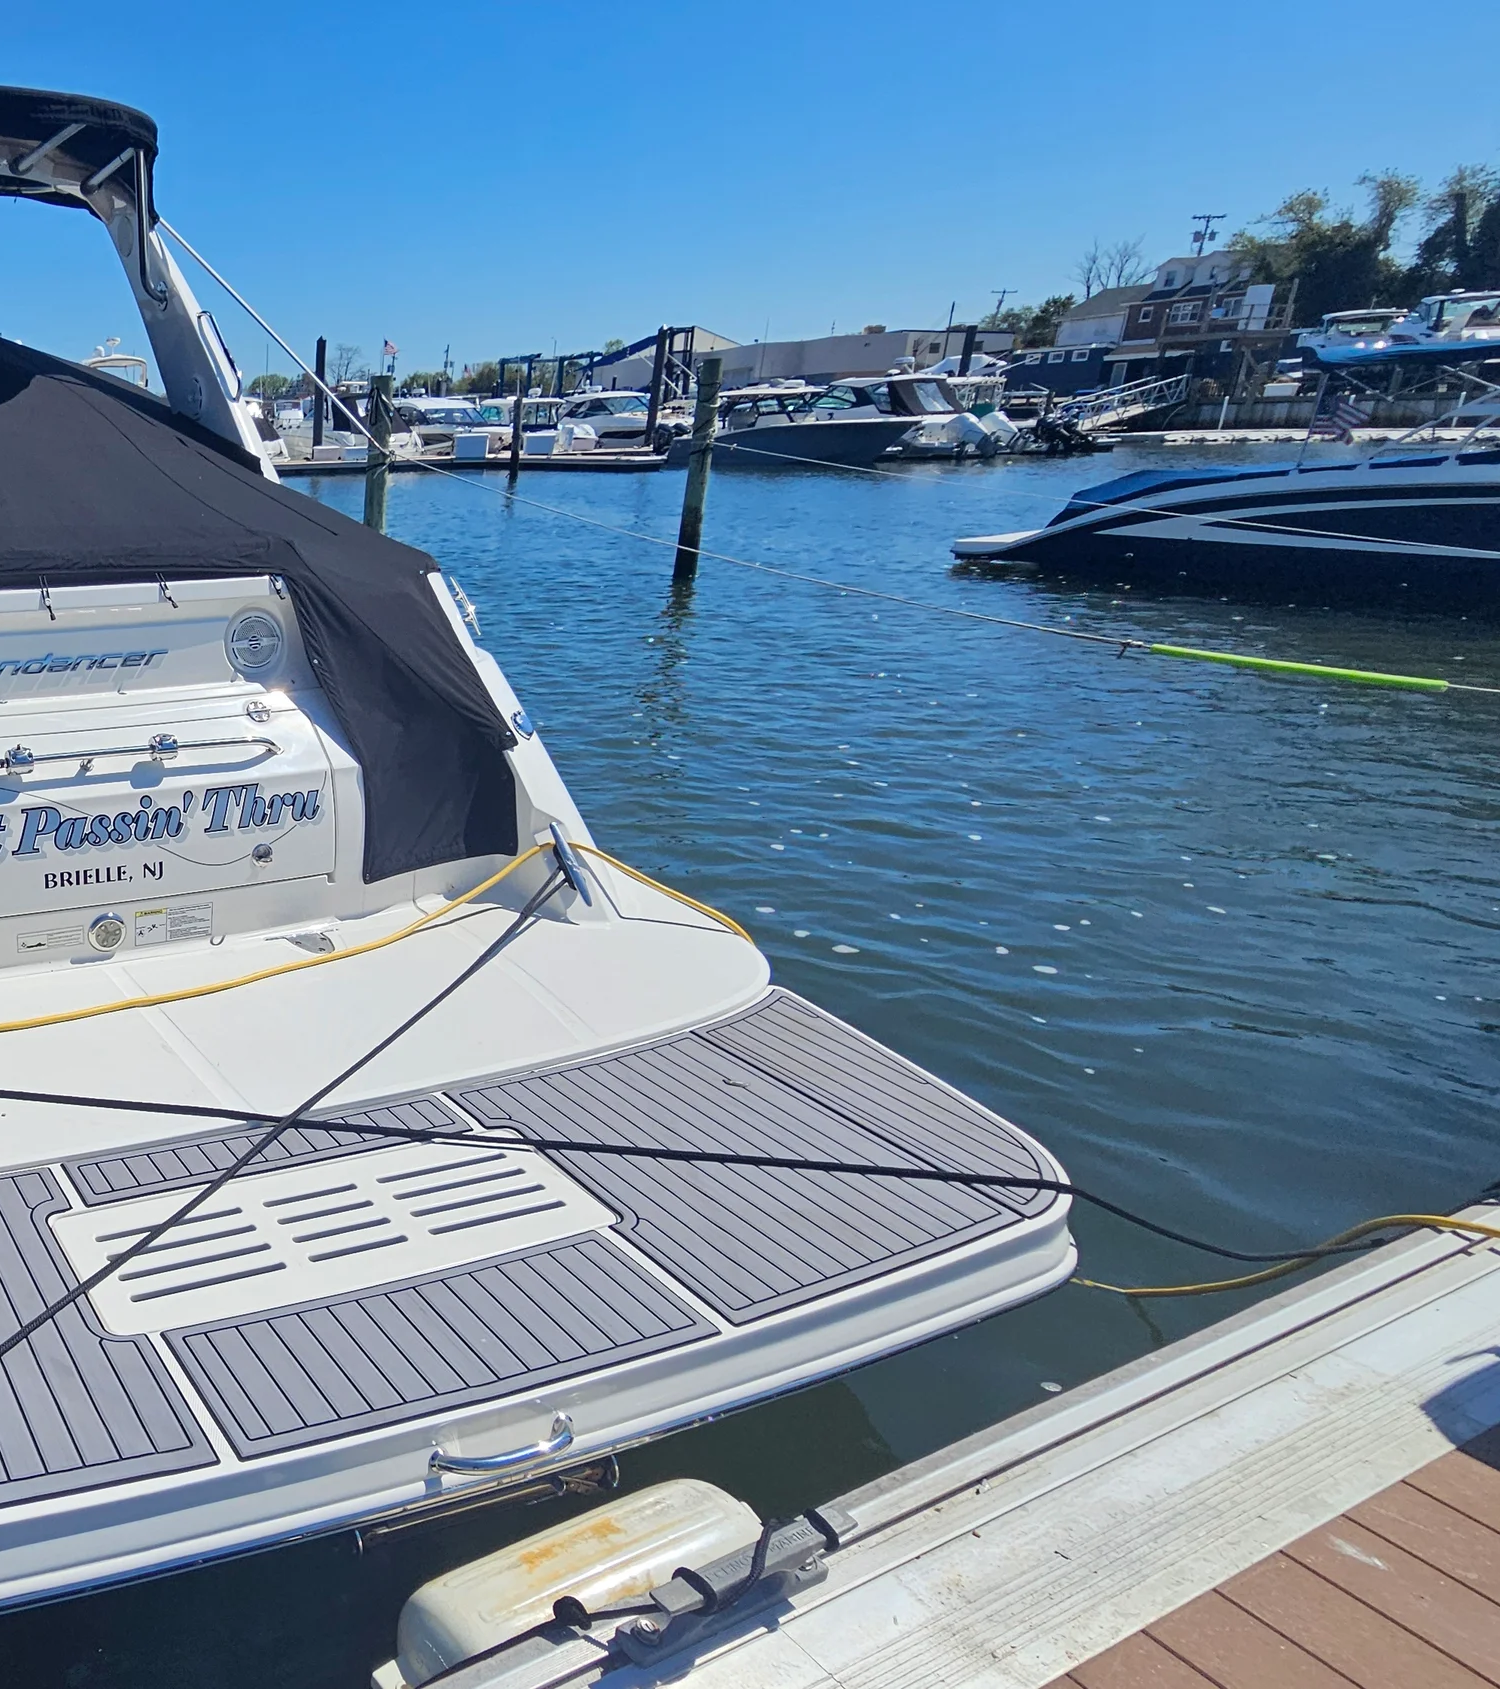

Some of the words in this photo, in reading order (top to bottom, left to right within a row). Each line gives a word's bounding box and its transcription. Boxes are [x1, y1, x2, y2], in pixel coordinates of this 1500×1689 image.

[12, 790, 193, 856] Passin'
[202, 782, 320, 834] Thru
[44, 864, 134, 889] BRIELLE,
[143, 861, 164, 881] NJ
